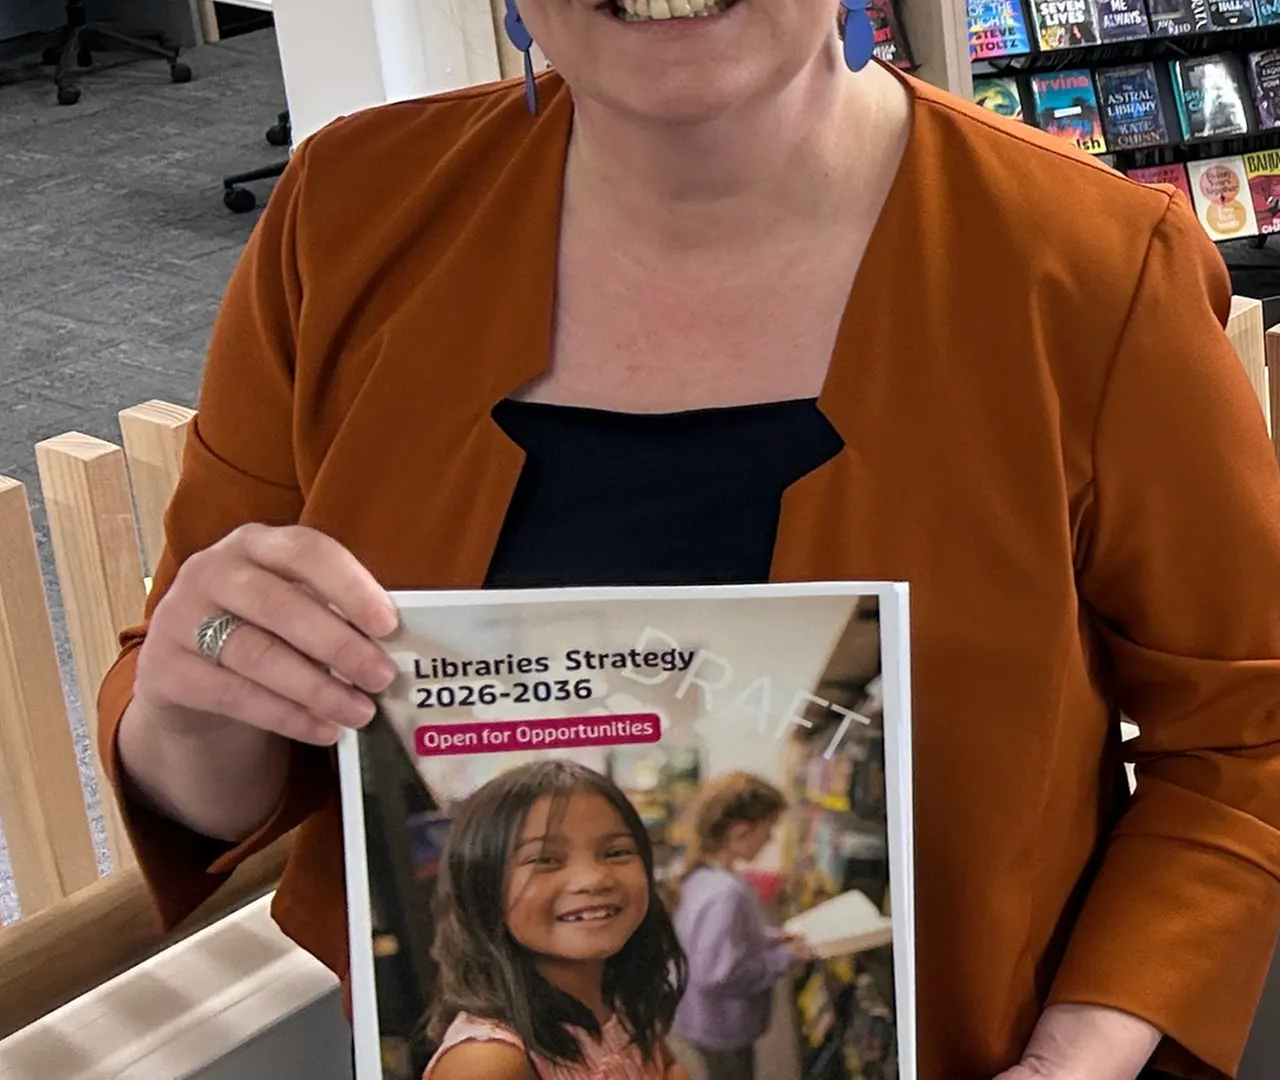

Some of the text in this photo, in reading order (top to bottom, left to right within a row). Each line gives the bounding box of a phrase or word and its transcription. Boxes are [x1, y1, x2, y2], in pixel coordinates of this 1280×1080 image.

[990, 0, 1014, 14] THE
[1039, 0, 1086, 16] SEVEN
[1045, 11, 1085, 26] LIVES
[1103, 10, 1142, 29] ALWAYS
[1036, 75, 1089, 92] Irvine
[1107, 90, 1153, 106] ASTRAL
[1107, 102, 1156, 118] LIBRARY
[1117, 131, 1161, 146] QUINN
[413, 647, 696, 680] Libraries Strategy
[415, 678, 593, 710] 2026-2036
[620, 626, 871, 760] DRAFT
[423, 717, 655, 751] Open for Opportunities
